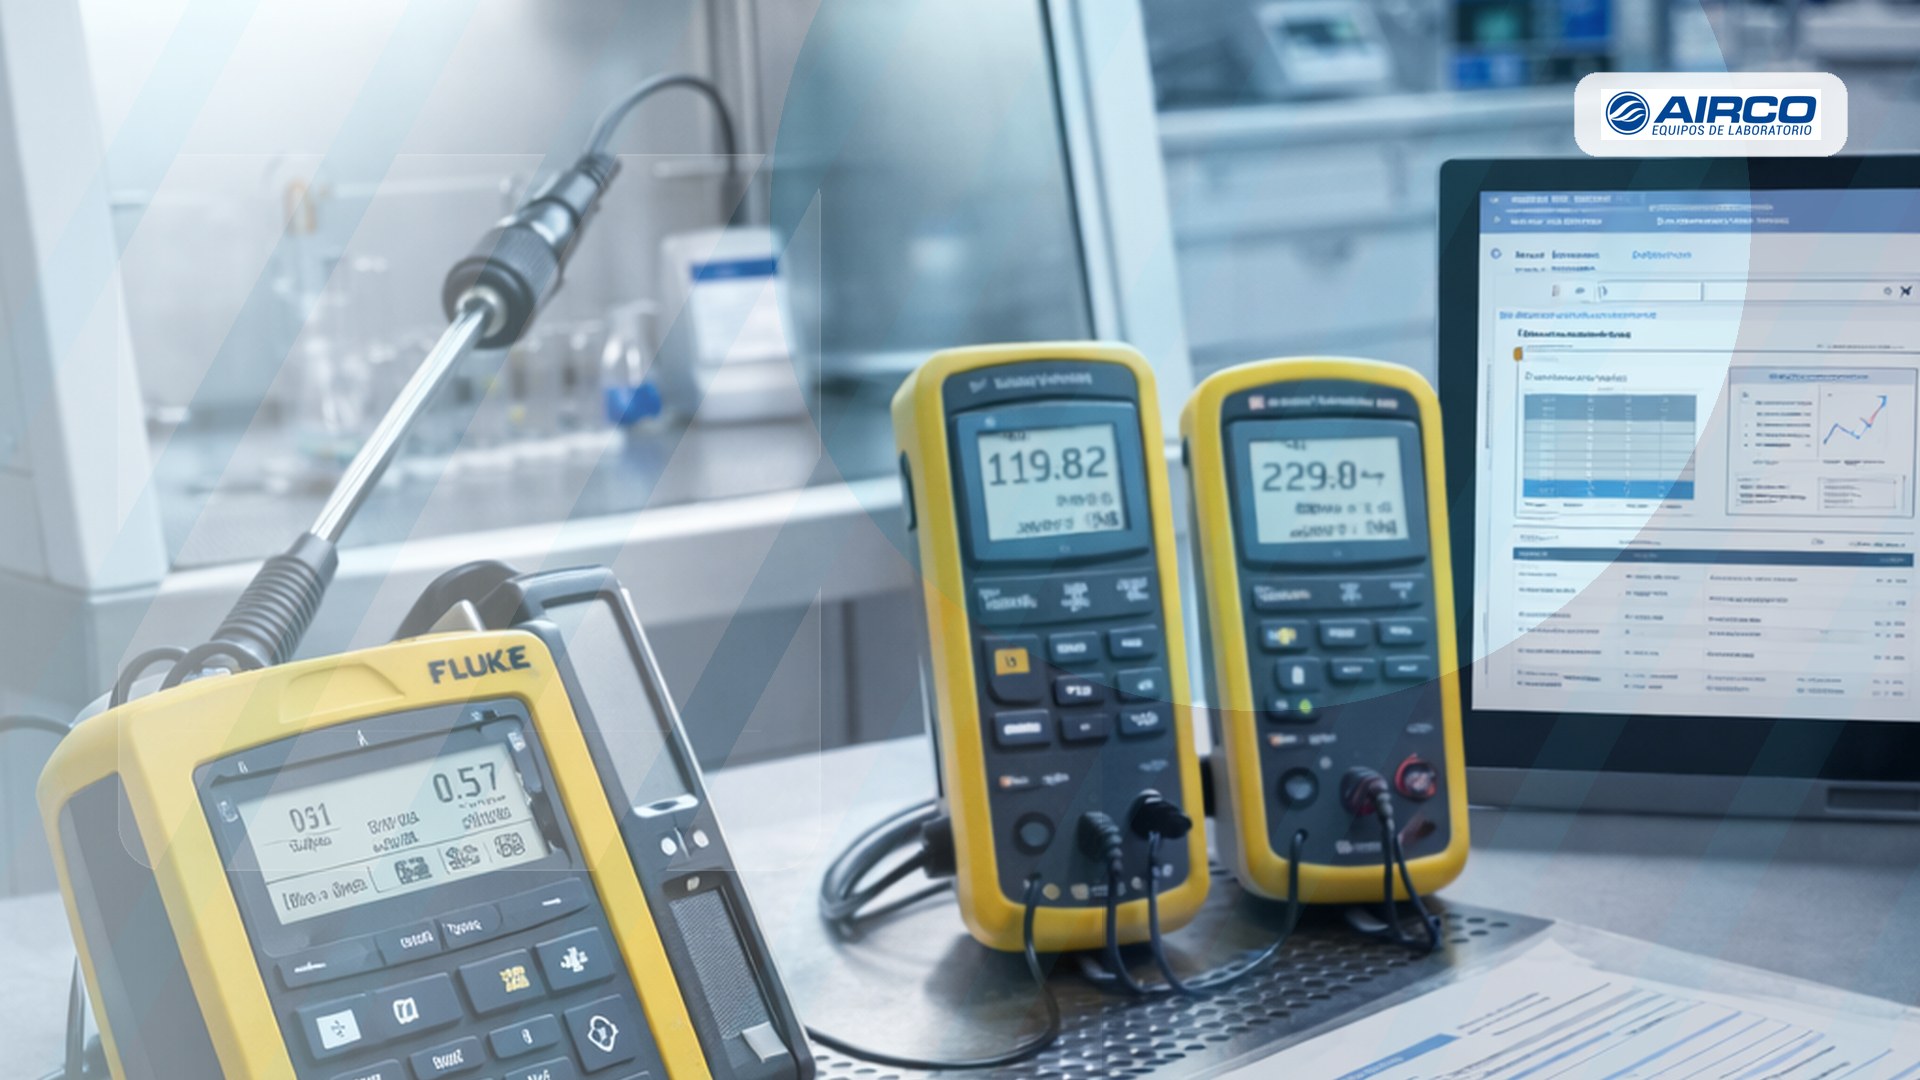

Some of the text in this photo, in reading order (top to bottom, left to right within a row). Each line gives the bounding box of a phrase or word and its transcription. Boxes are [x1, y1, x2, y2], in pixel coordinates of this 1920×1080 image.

[988, 446, 1109, 485] 119.82
[428, 646, 531, 683] FLUKE
[433, 762, 499, 803] 0.57
